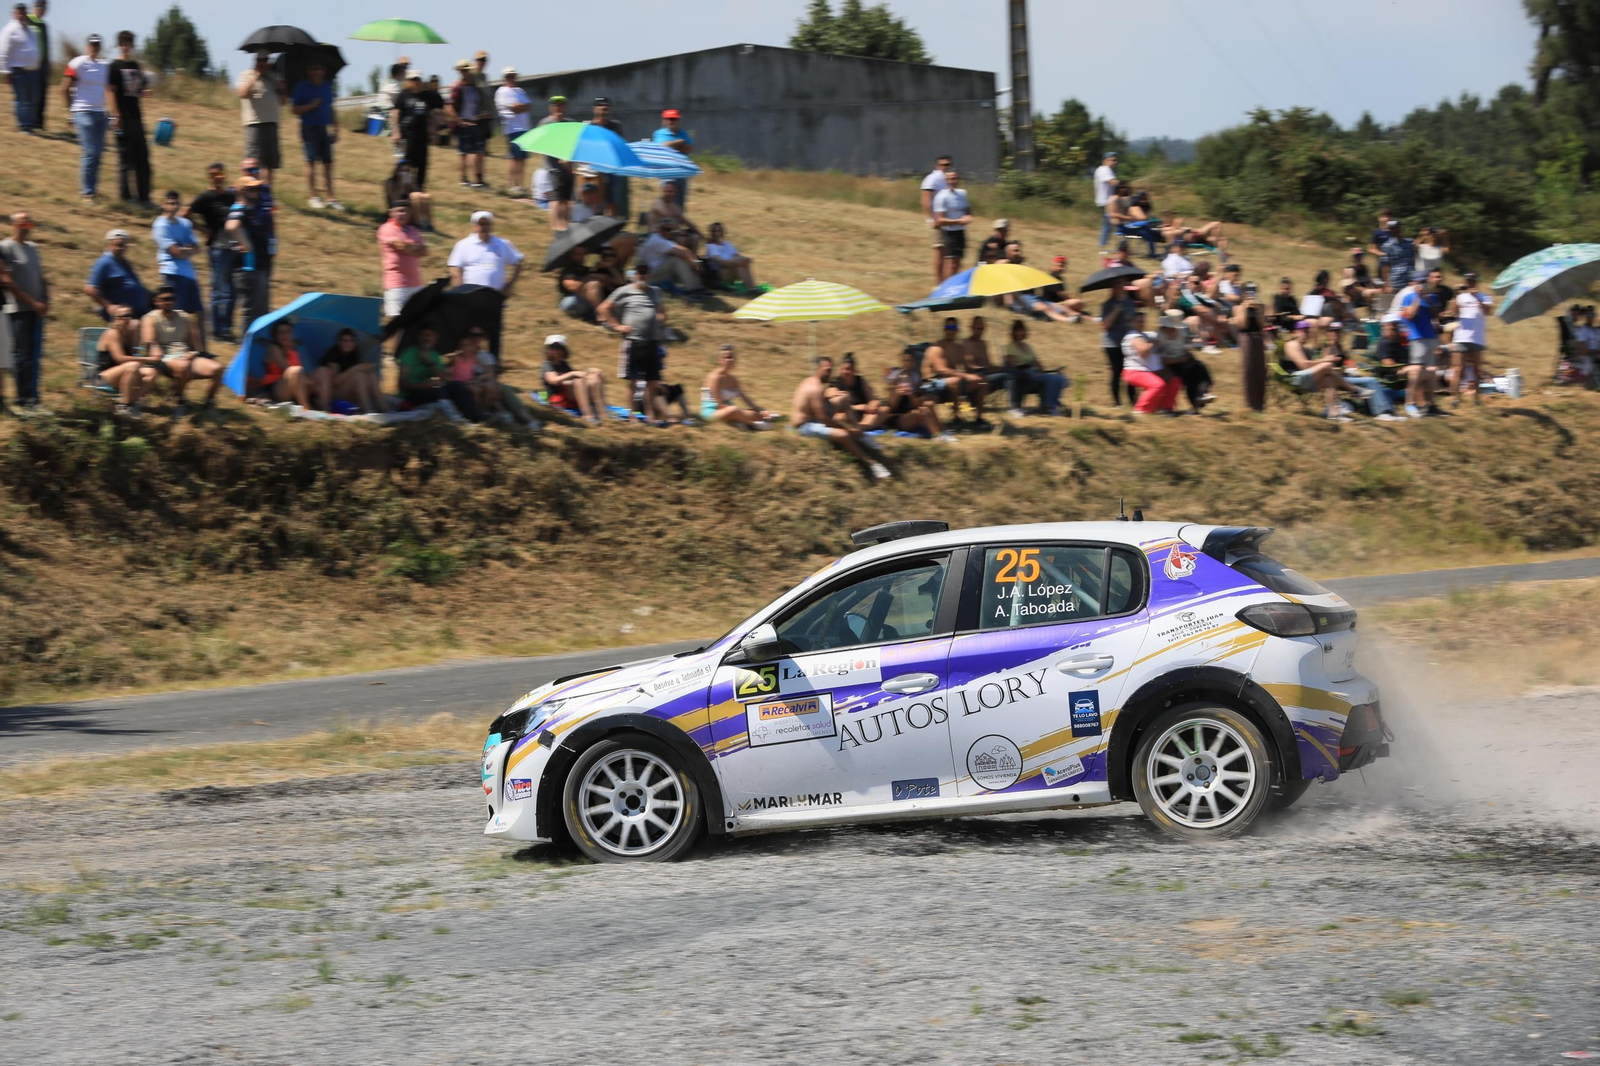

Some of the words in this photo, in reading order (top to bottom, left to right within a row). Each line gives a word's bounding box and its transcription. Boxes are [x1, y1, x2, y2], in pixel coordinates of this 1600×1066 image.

[995, 548, 1040, 583] 25
[997, 585, 1024, 599] J.A.
[1028, 583, 1073, 599] López
[994, 604, 1010, 618] A.
[1011, 600, 1075, 616] Taboada
[1157, 618, 1205, 638] TRANSPORTES
[1206, 612, 1224, 621] JUAN
[739, 666, 776, 695] 25
[782, 667, 807, 681] La
[771, 701, 808, 716] Recalvi
[837, 696, 949, 752] AUTOS
[956, 667, 1050, 718] LORY
[775, 723, 811, 735] recoletas
[812, 720, 832, 730] salud
[995, 772, 1018, 780] VIVIENDA
[1057, 762, 1082, 776] AceroPlus
[905, 782, 937, 799] Pote
